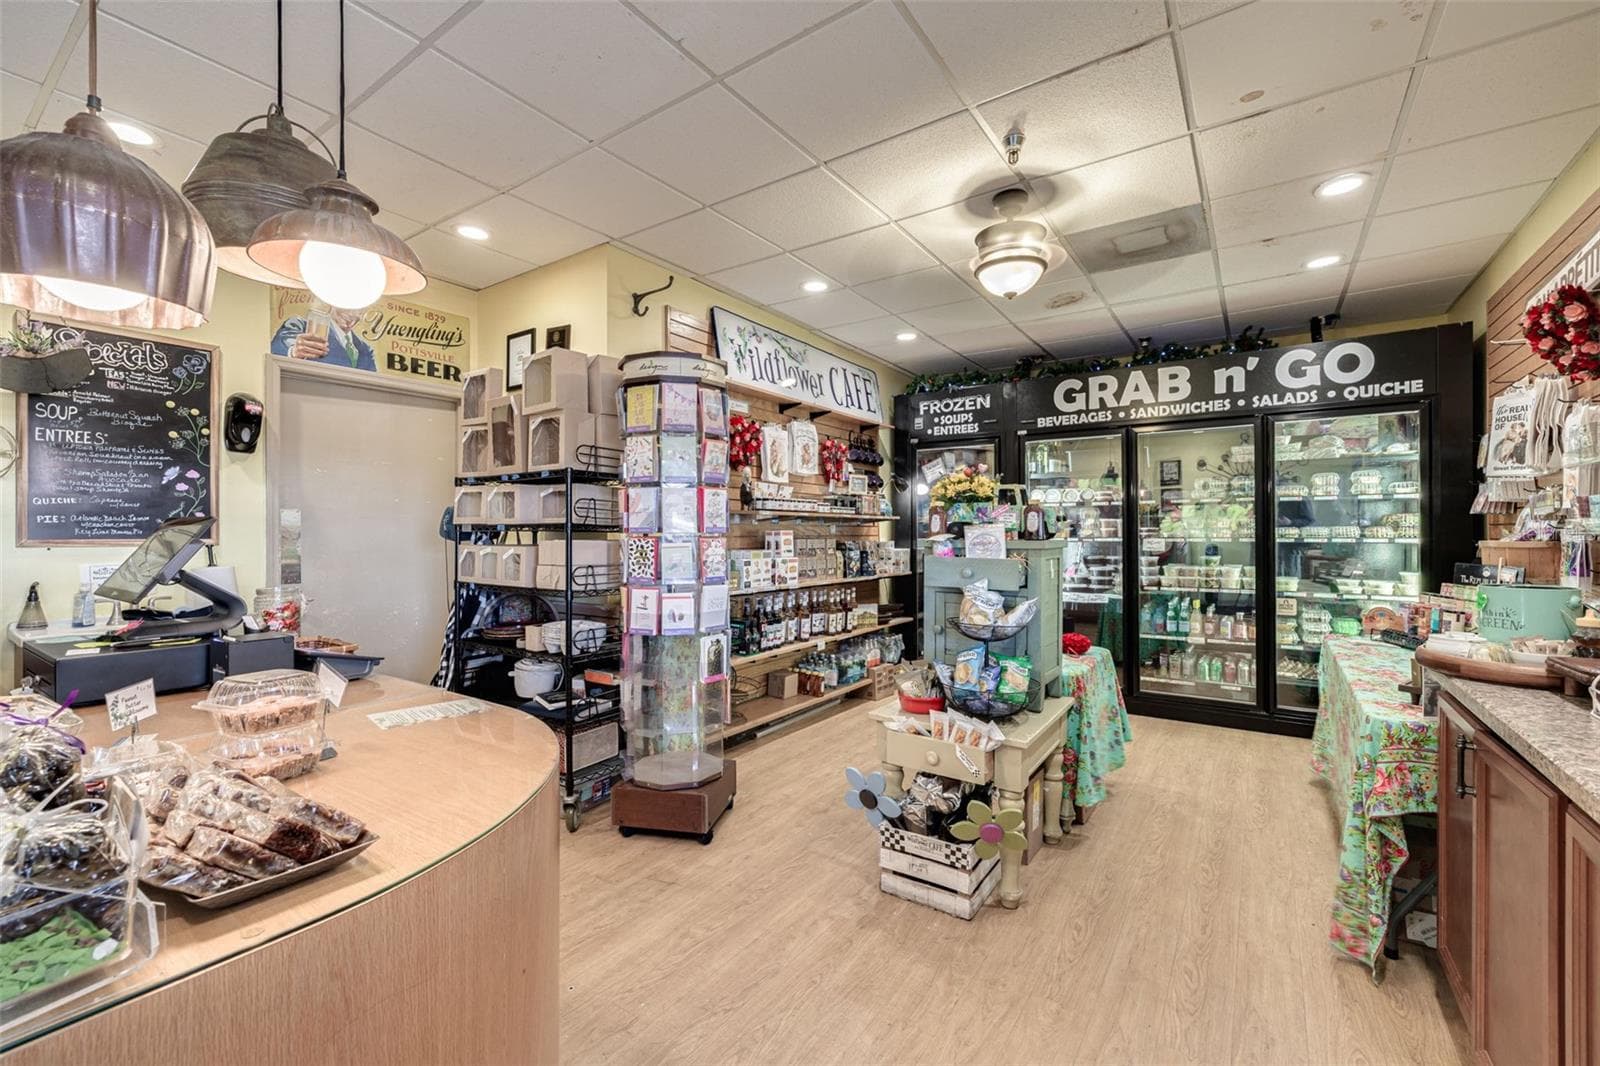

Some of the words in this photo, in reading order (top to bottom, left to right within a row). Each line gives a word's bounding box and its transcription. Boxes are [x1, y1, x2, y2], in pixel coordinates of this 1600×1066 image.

[387, 302, 420, 317] SINCE
[424, 311, 447, 324] 1829
[362, 308, 466, 350] Yuengling's
[386, 352, 462, 383] BEER
[1053, 365, 1192, 413] GRAB
[1274, 341, 1375, 390] GO
[828, 366, 877, 414] CAFE
[919, 394, 991, 416] FROZEN
[1036, 409, 1113, 429] BEVERAGES
[1129, 397, 1232, 420] SANDWICHES
[1251, 389, 1319, 409] SALADS
[1343, 379, 1424, 401] QUICHE
[933, 422, 979, 437] ENTREES
[939, 412, 974, 426] SOUPS
[1494, 423, 1506, 431] OF
